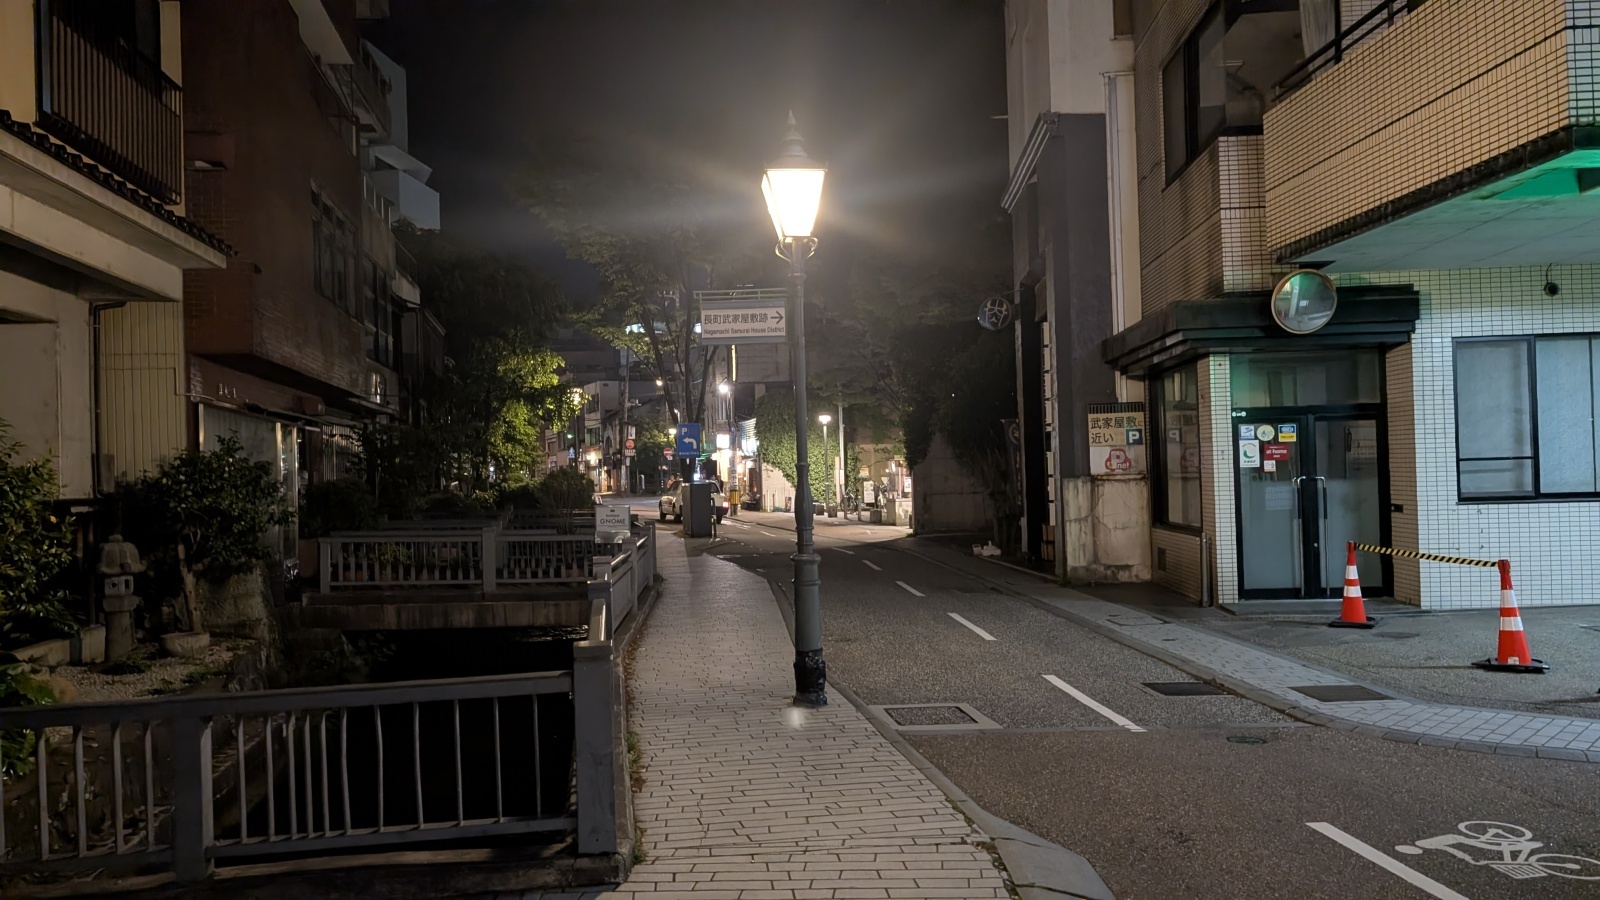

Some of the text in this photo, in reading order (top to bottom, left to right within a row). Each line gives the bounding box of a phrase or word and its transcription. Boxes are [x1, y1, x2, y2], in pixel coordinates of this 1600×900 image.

[704, 313, 768, 325] 長町武家屋敷跡
[704, 327, 730, 336] Nagamachi
[1090, 416, 1144, 429] 武家屋敷に
[682, 428, 688, 436] P
[1091, 431, 1140, 444] 近い P
[1117, 461, 1130, 469] net
